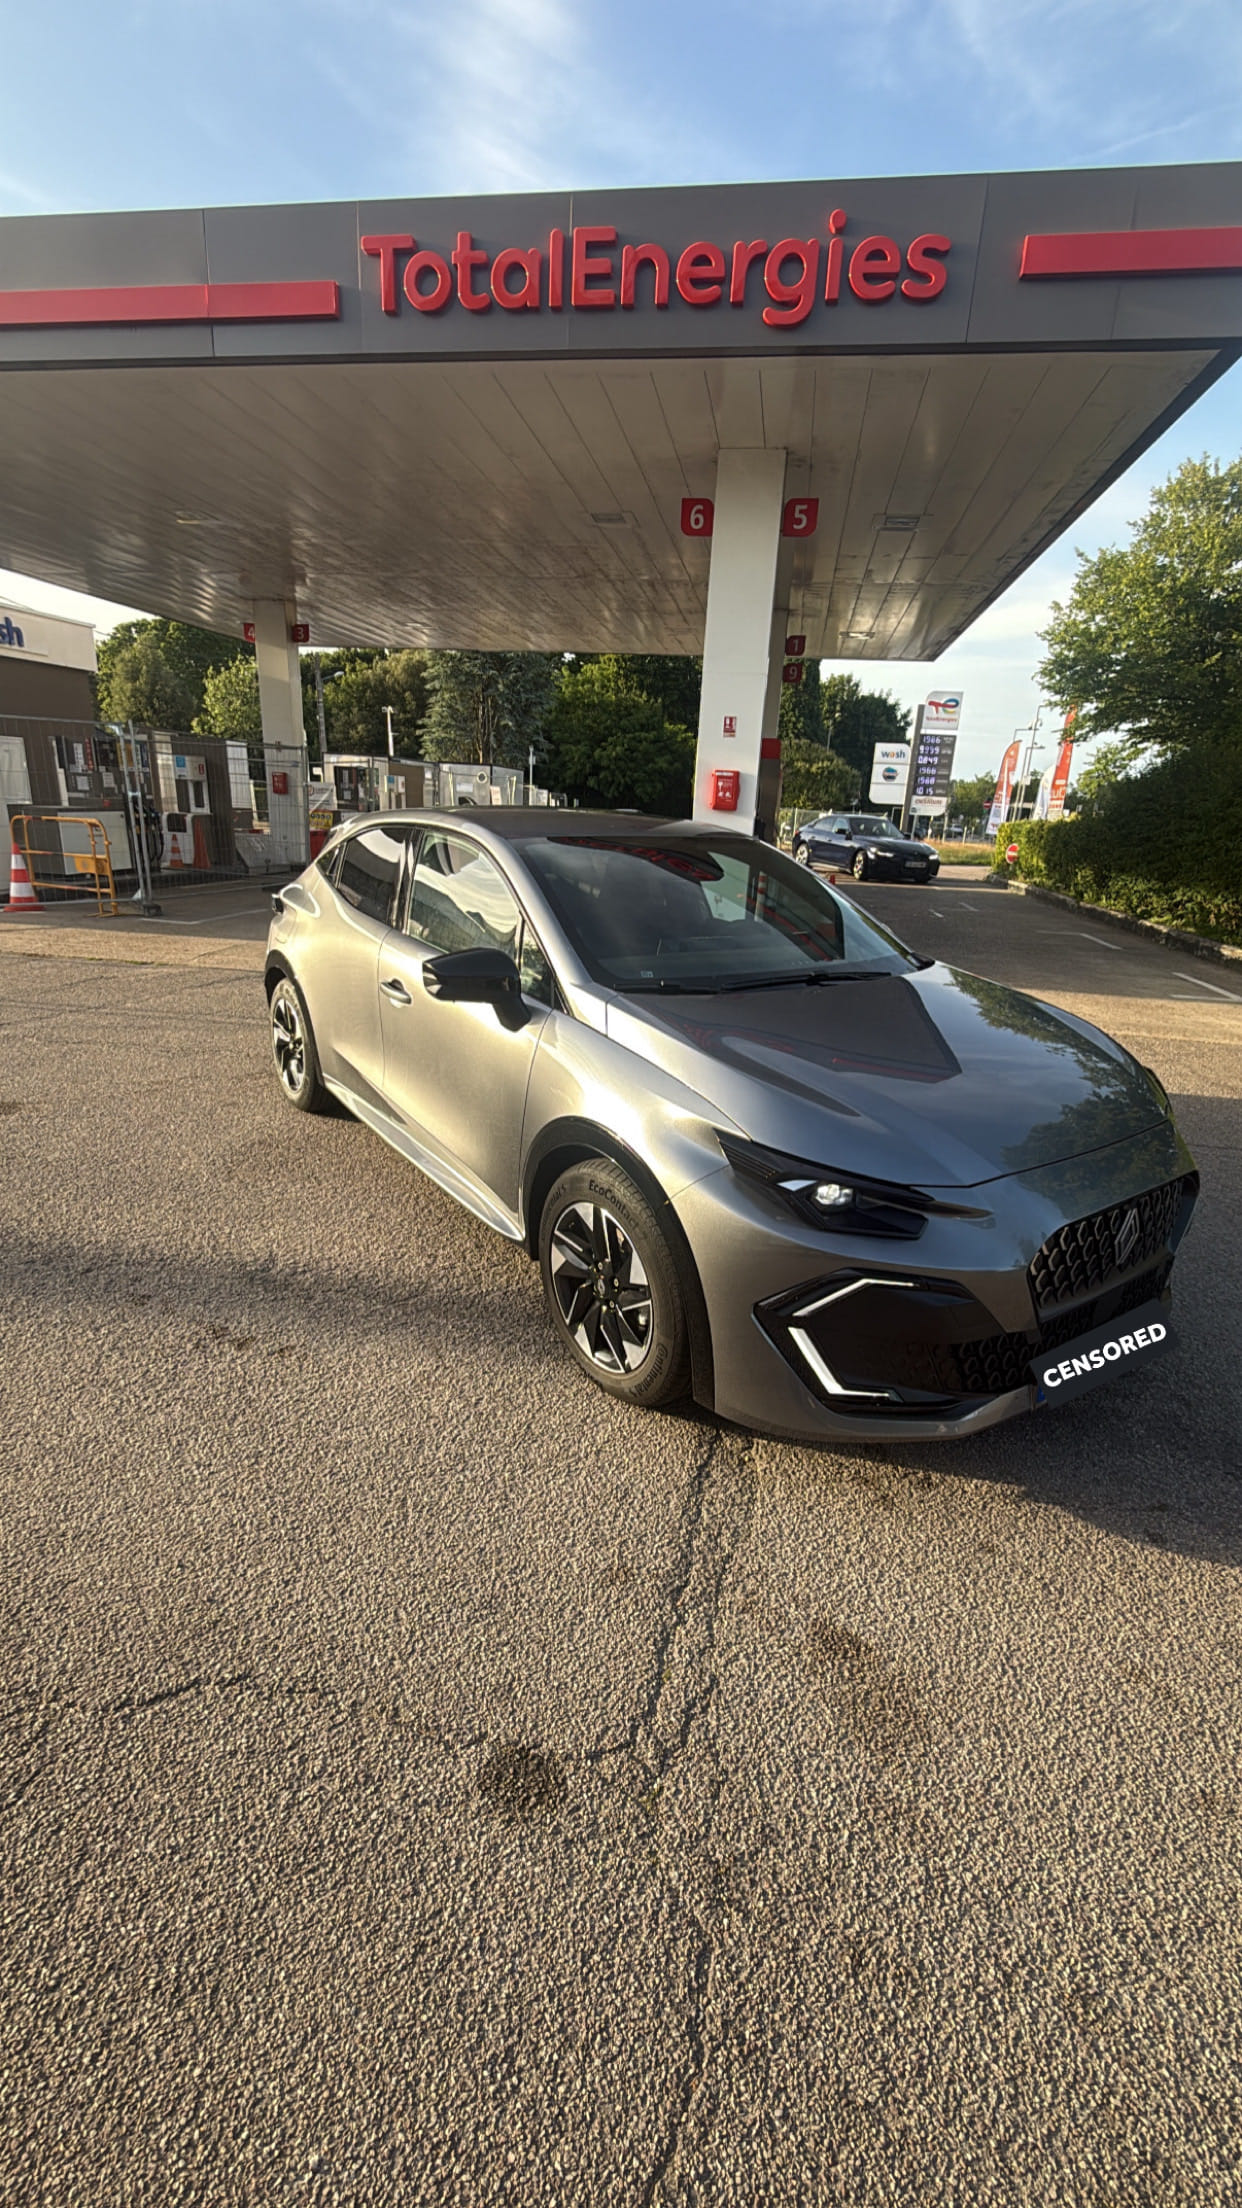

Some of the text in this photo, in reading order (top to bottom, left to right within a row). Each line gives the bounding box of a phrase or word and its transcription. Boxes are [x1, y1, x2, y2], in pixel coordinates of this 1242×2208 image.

[360, 209, 952, 328] TotalEnergies
[690, 505, 704, 529] 6
[792, 504, 808, 530] 5
[248, 626, 256, 639] 4
[297, 627, 304, 640] 3
[789, 666, 797, 679] 9
[881, 749, 906, 759] wash
